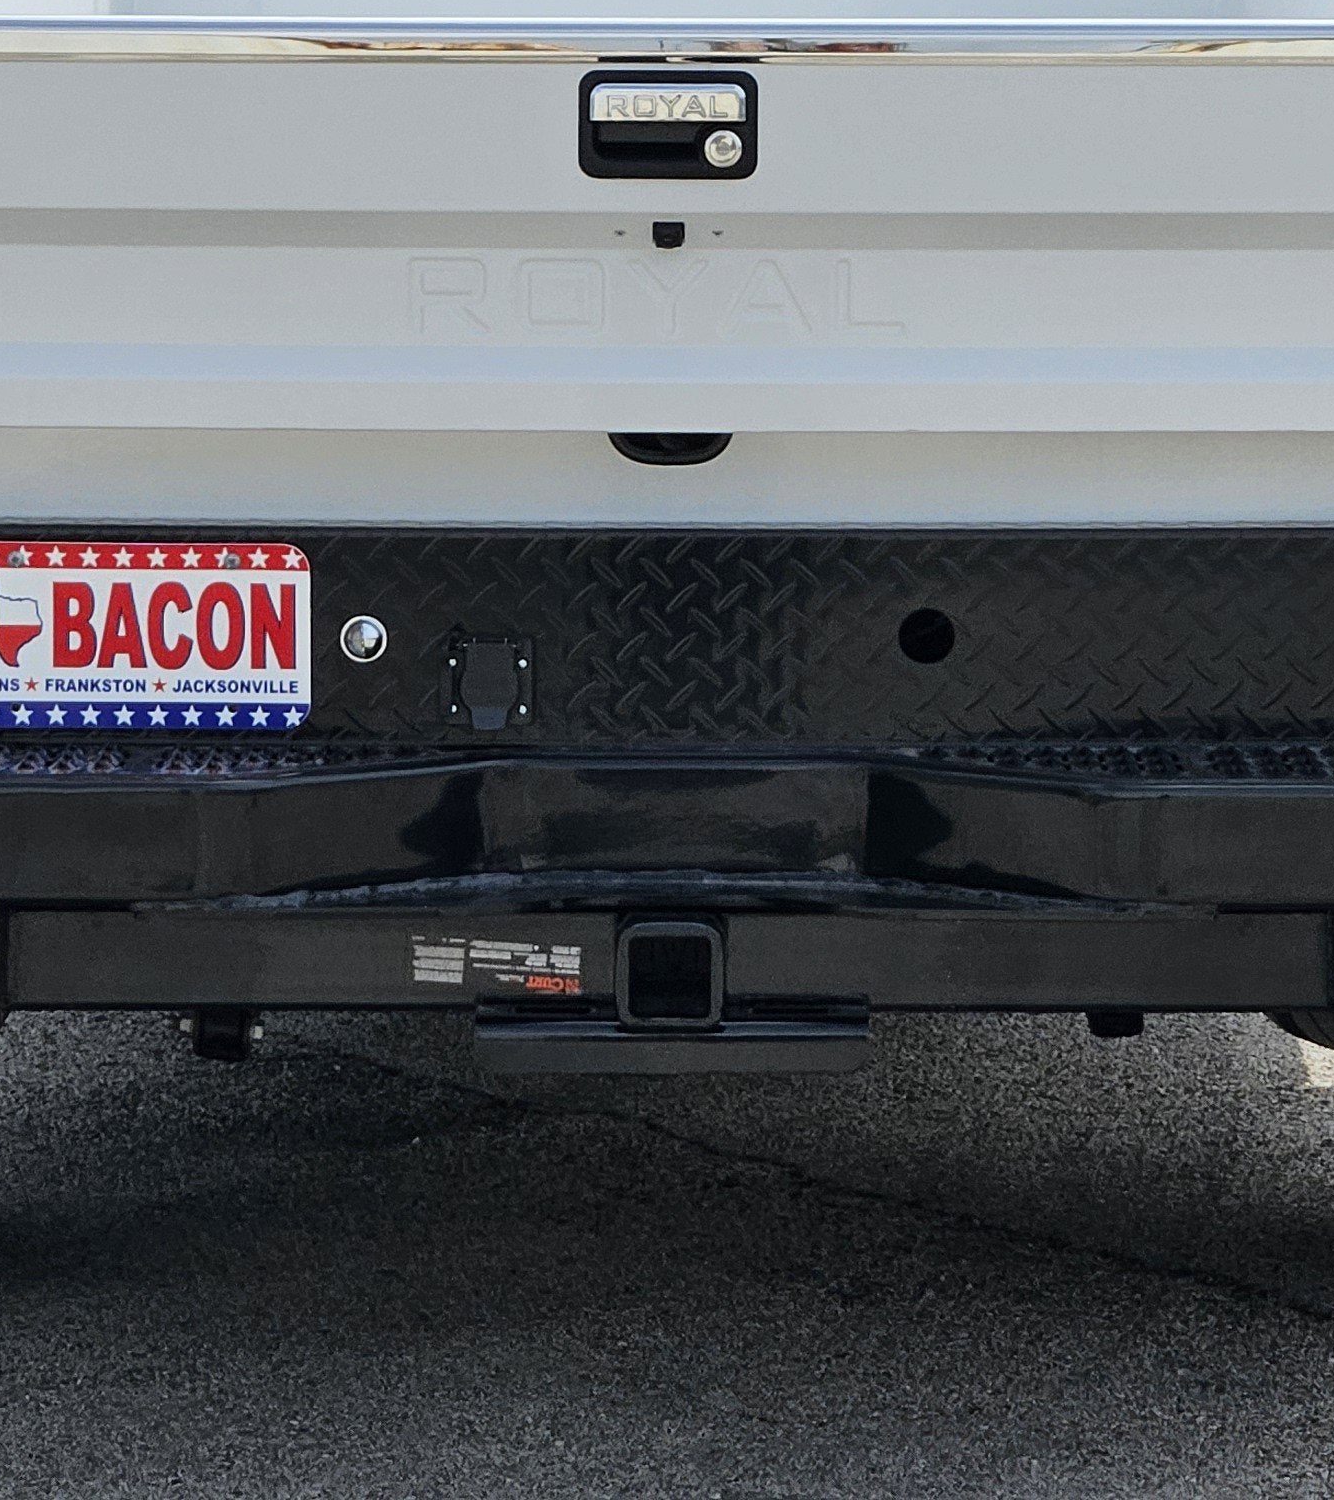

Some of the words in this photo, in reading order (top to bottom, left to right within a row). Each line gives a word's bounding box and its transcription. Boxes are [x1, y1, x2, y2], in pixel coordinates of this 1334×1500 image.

[605, 94, 729, 119] ROYAL
[406, 256, 909, 336] ROYAL
[52, 580, 297, 671] BACON
[44, 678, 147, 694] FRANKSTON
[171, 679, 299, 695] JACKSONVILLE
